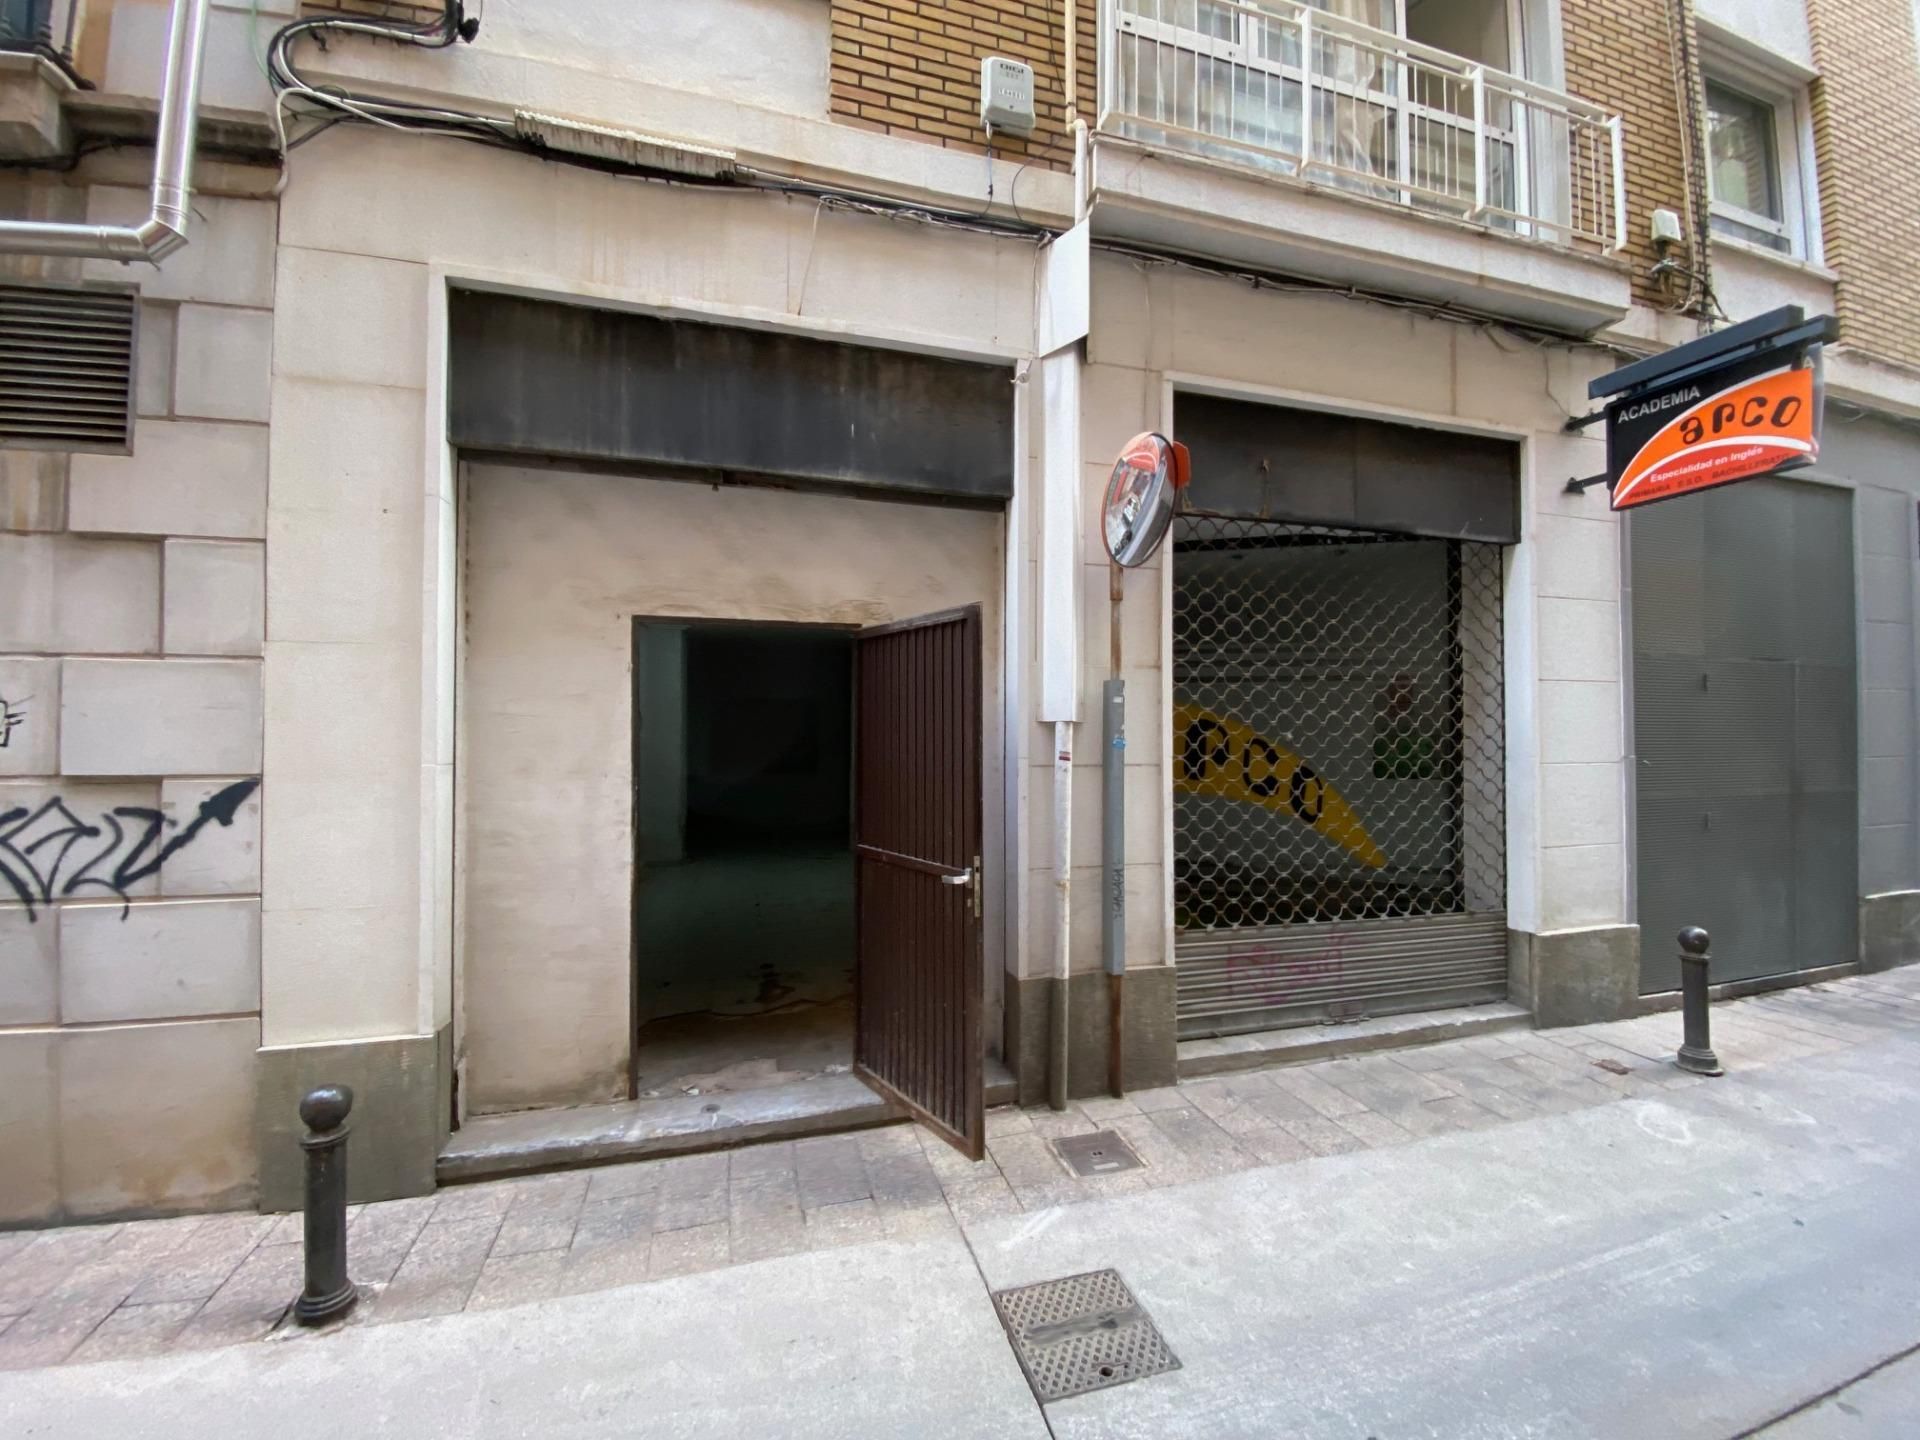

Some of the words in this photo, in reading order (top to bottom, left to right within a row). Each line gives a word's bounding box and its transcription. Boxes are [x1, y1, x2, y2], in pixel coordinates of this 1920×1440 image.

[1617, 385, 1701, 424] ACADEMIA
[1679, 396, 1802, 445] arco
[1650, 458, 1713, 483] Especialidad
[1715, 455, 1729, 467] en
[1730, 446, 1764, 463] Inglés
